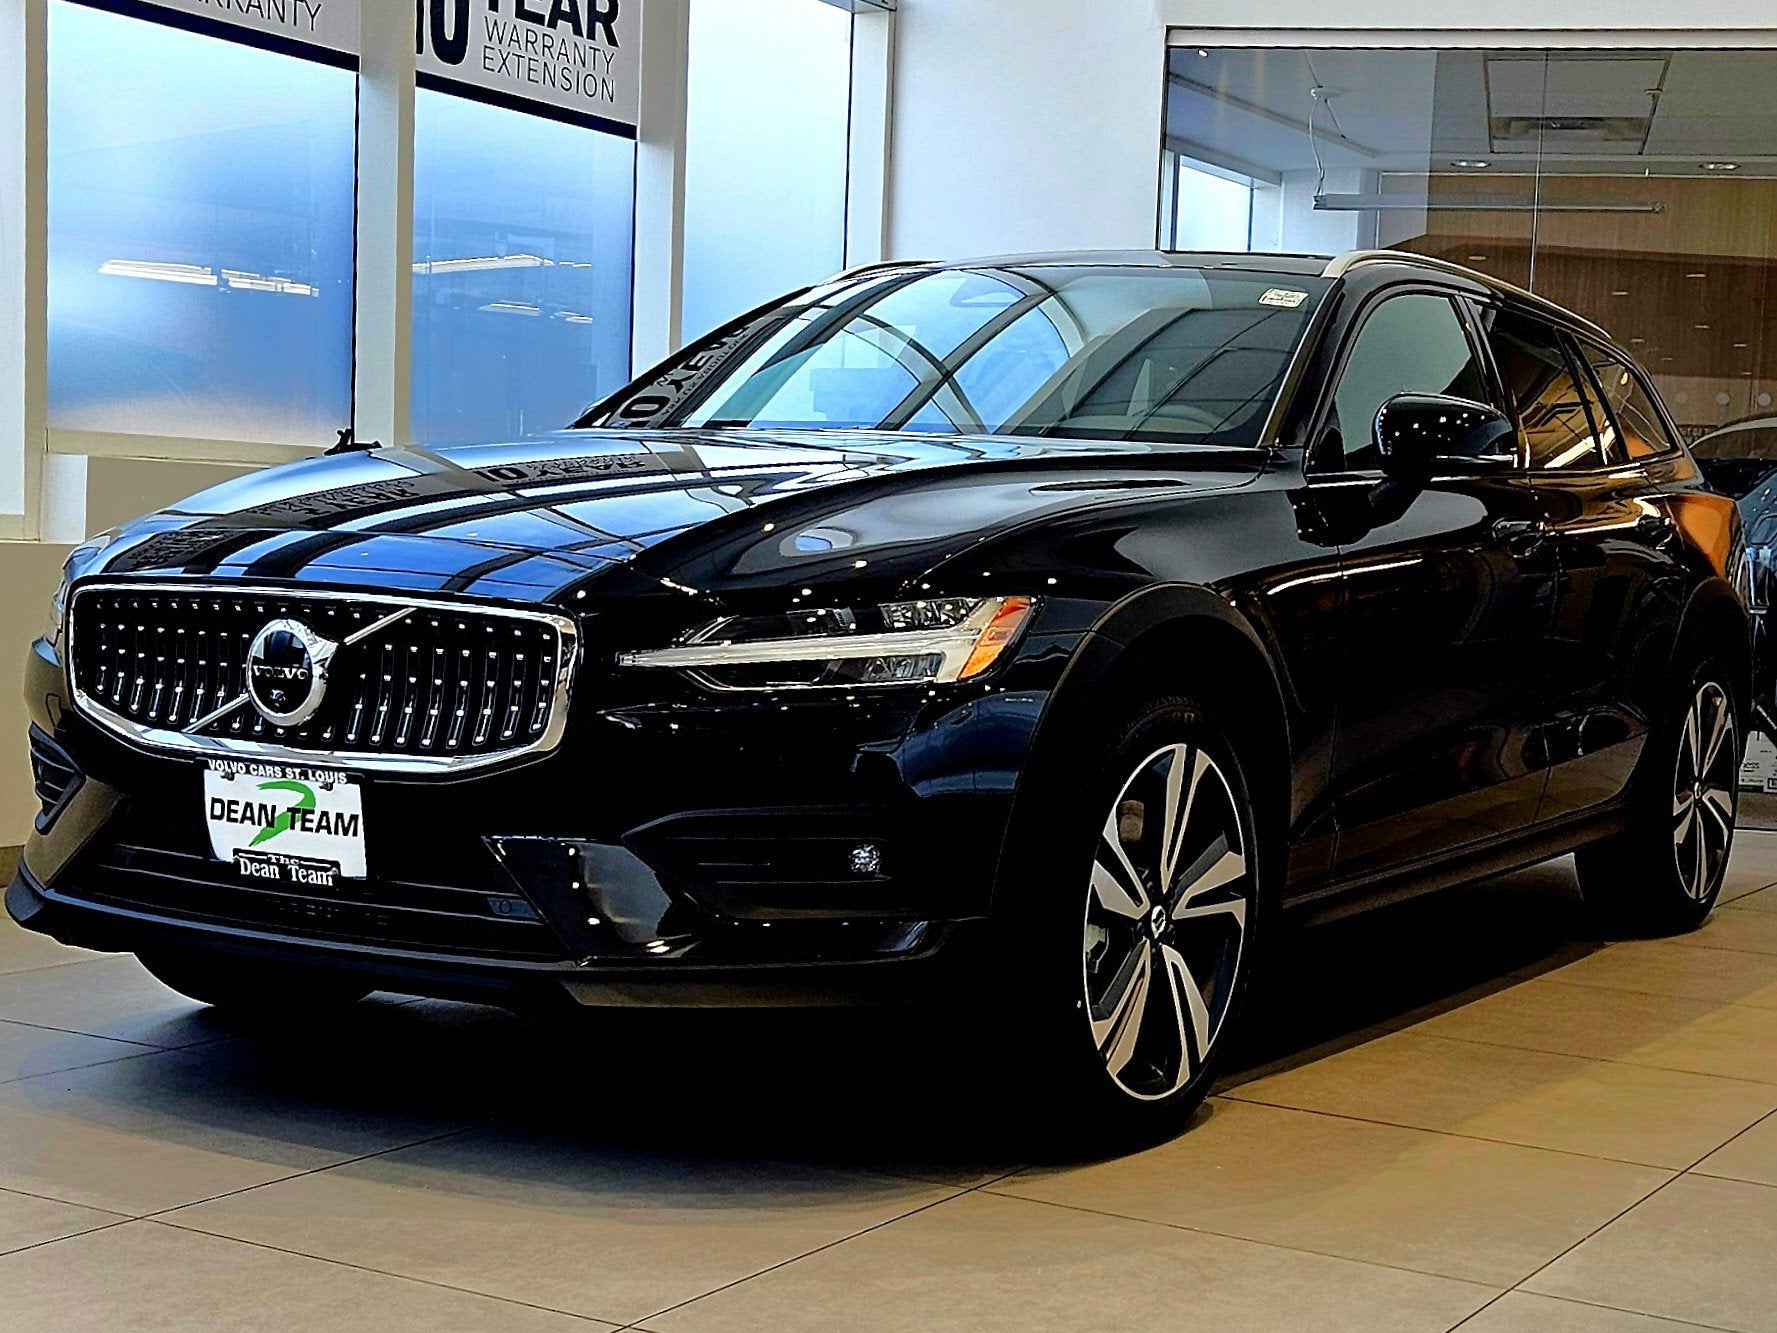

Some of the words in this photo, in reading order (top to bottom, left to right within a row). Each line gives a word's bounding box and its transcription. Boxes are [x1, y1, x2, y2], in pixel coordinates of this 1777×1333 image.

[204, 0, 321, 32] ANTY
[415, 0, 470, 66] 0
[488, 0, 625, 49] AR
[484, 15, 615, 75] WARRANTY
[483, 45, 615, 103] EXTENSION
[253, 665, 309, 680] VOLVO
[208, 758, 246, 775] VOLVO
[249, 764, 283, 779] CARS
[285, 768, 305, 781] ST.
[308, 771, 347, 784] LOUIS
[210, 796, 277, 829] DEAN
[286, 806, 360, 838] TEAM
[239, 857, 281, 879] Dean
[287, 864, 334, 887] Team
[269, 854, 300, 865] The
